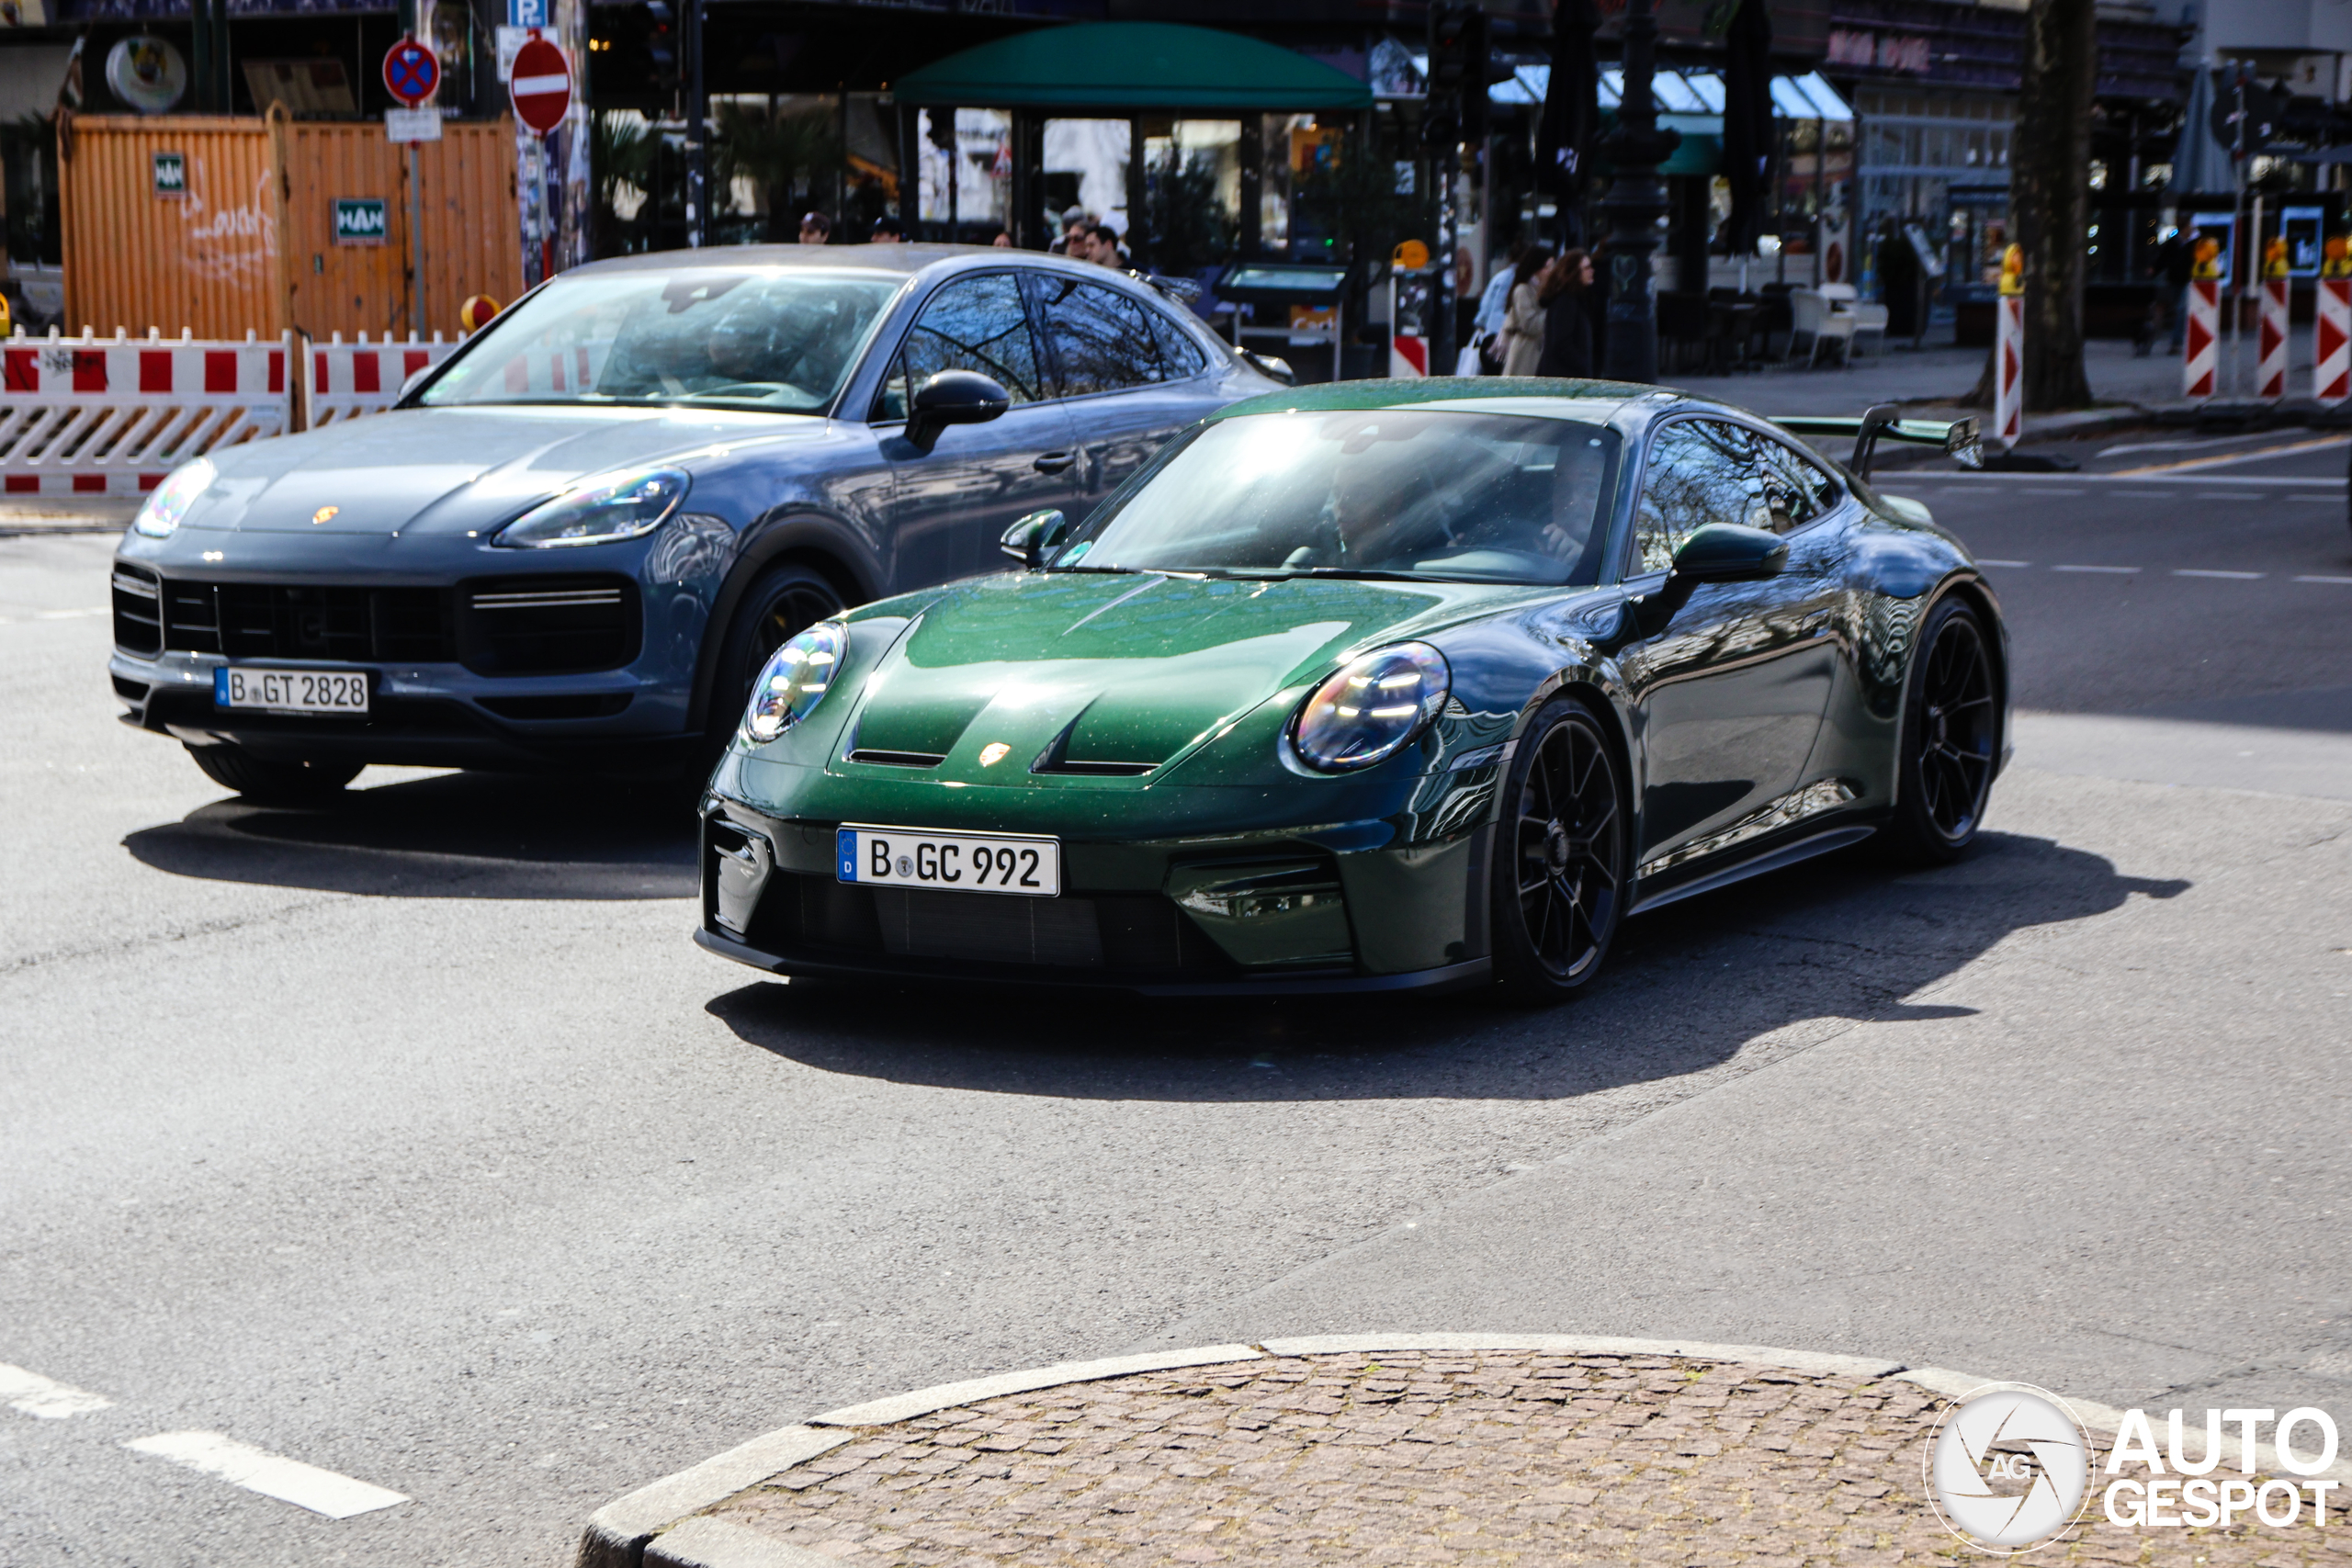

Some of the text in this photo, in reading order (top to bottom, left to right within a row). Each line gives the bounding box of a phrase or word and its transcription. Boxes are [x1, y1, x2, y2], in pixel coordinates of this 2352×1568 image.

[338, 207, 383, 232] HAN
[232, 673, 245, 701] B
[264, 674, 294, 704] GT
[301, 676, 365, 706] 2828
[843, 861, 853, 874] D
[871, 839, 1041, 887] B GC 992
